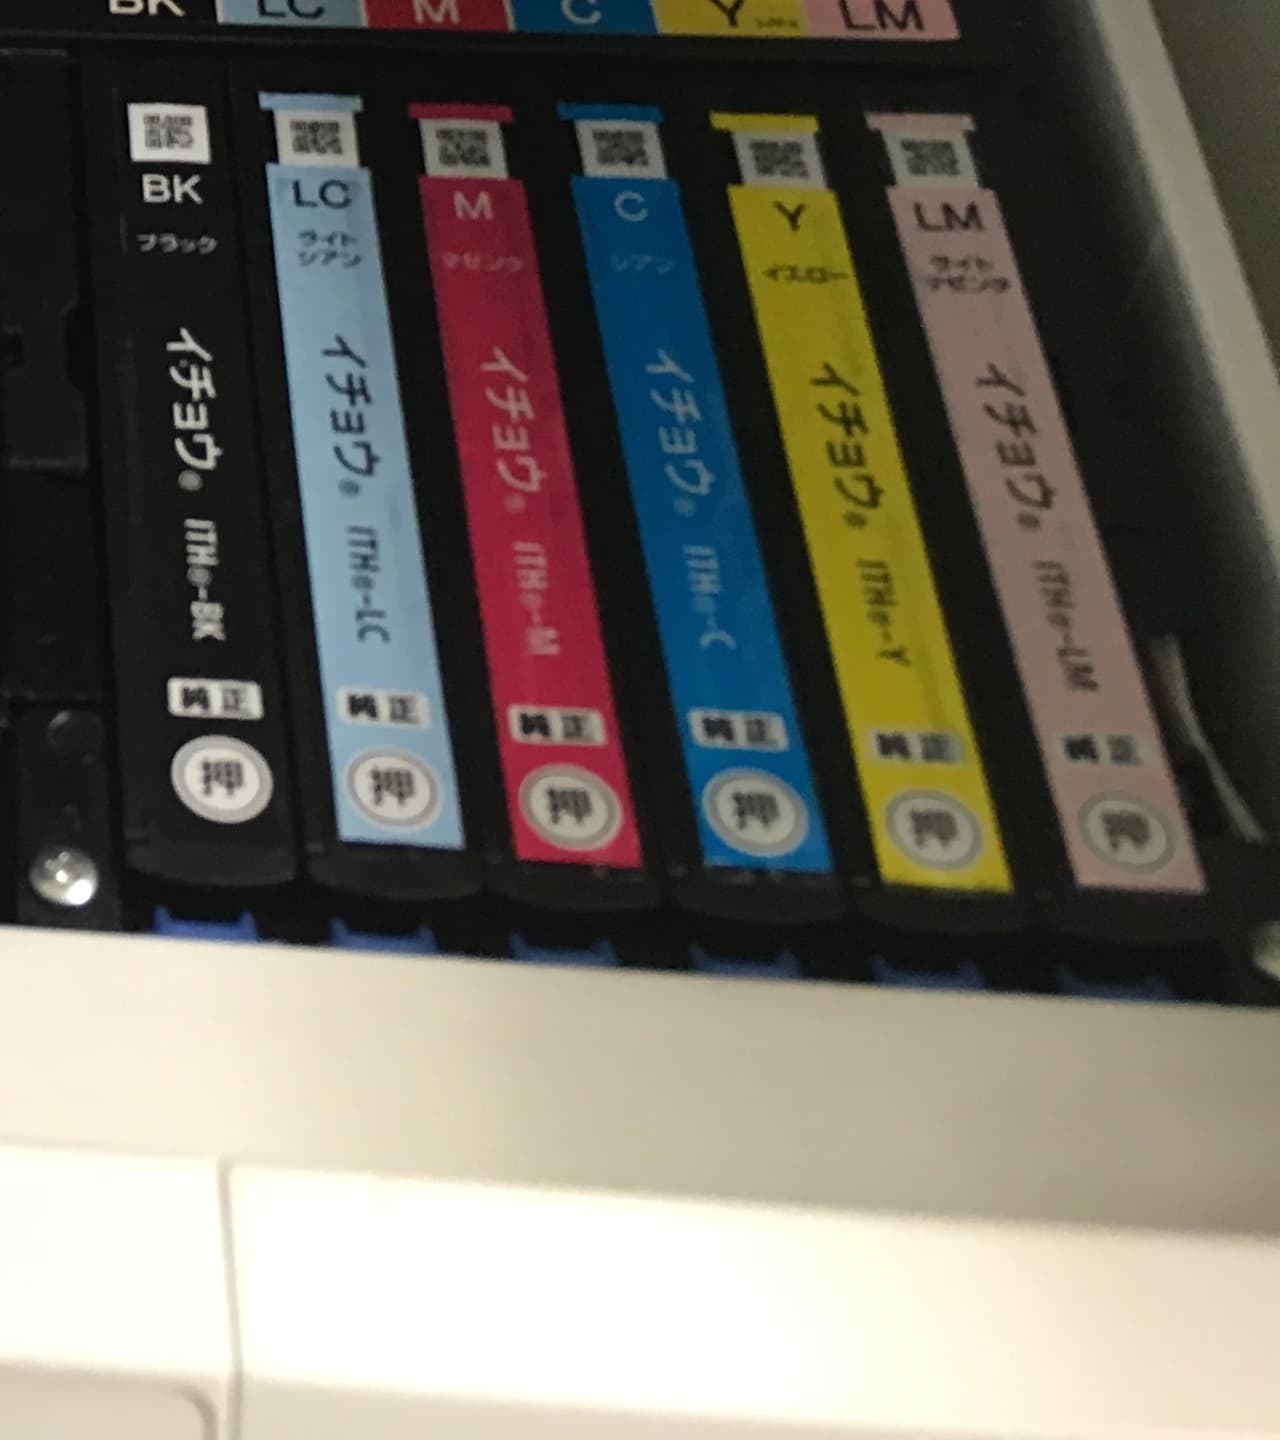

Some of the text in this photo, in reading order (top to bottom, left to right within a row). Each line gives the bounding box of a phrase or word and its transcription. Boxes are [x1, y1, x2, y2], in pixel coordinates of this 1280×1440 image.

[142, 173, 204, 205] BK
[293, 179, 353, 208] LC
[453, 191, 493, 220] M
[614, 190, 649, 222] C
[773, 201, 806, 231] Y
[913, 201, 984, 232] LM
[136, 232, 218, 255] ブラック
[202, 756, 244, 796] 押
[371, 766, 413, 806] 押
